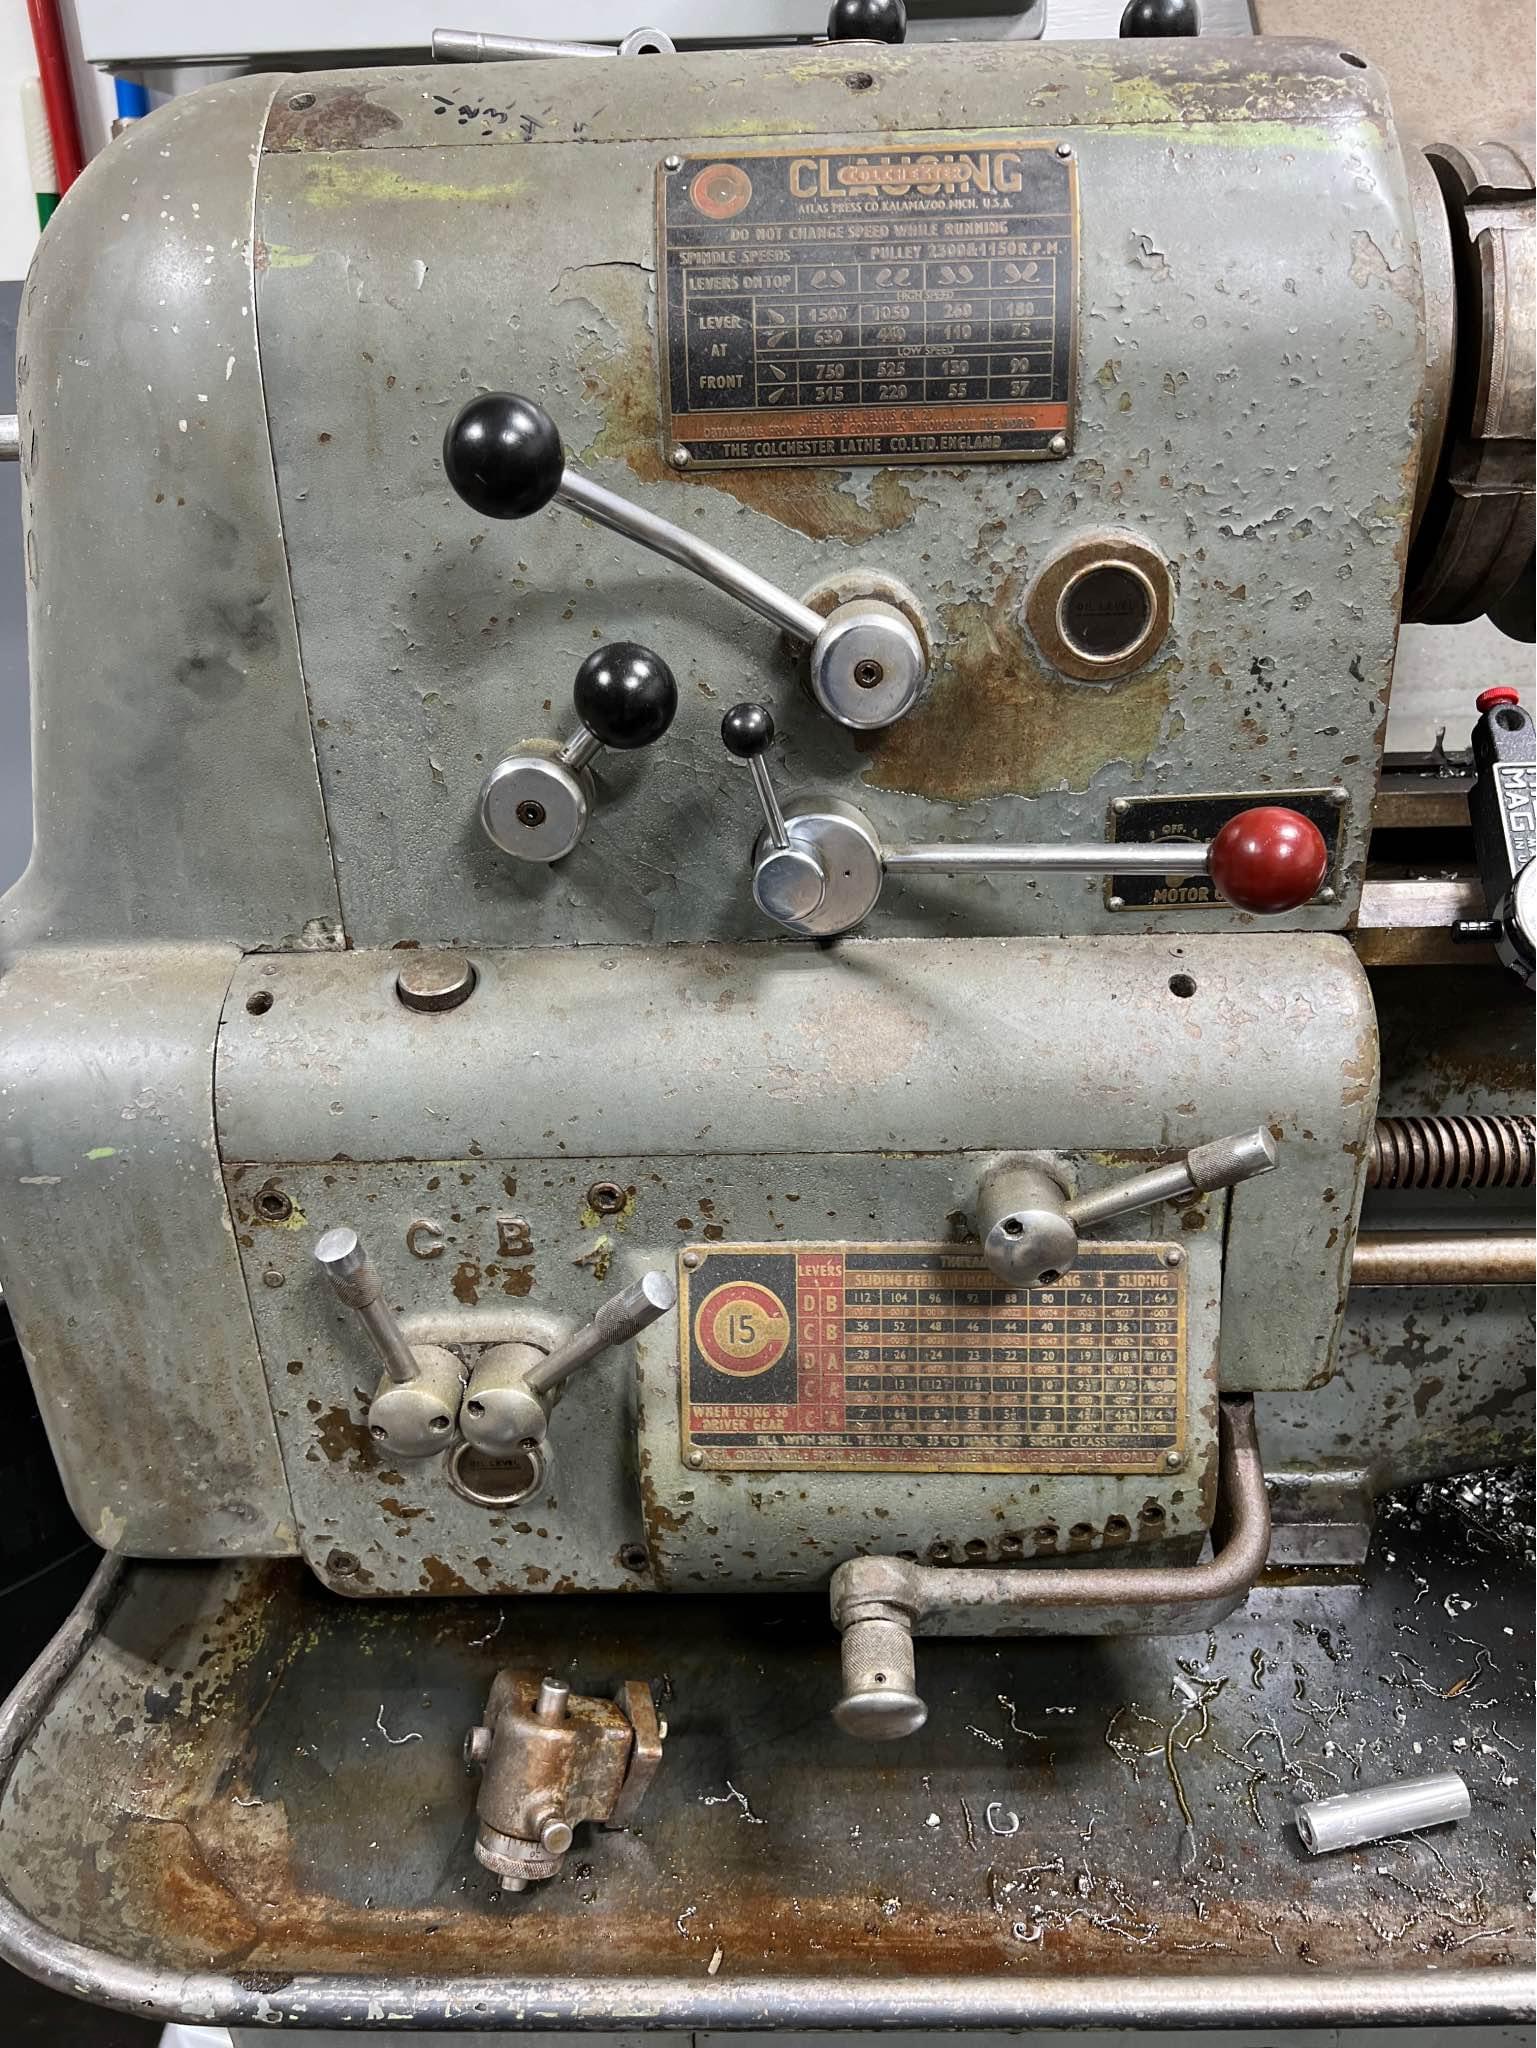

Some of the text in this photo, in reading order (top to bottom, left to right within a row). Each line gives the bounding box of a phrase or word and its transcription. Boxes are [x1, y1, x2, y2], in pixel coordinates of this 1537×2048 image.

[800, 203, 828, 214] ATLAS
[832, 202, 864, 213] PRESS
[730, 221, 1008, 241] DO NOT CHANGE SPEED WHILE RUNNING
[680, 248, 791, 265] SPINDLE SPEEDS
[871, 246, 922, 260] PULLEY
[690, 275, 792, 291] LEVERS ON TOP
[809, 307, 848, 324] 1500
[873, 304, 910, 321] 1050
[700, 316, 742, 330] LEVER
[1012, 323, 1031, 339] 75
[711, 344, 727, 357] AT
[898, 346, 955, 357] LOW SPEED
[816, 364, 845, 380] 750
[877, 361, 906, 377] 525
[1010, 357, 1030, 373] 90
[700, 375, 744, 390] FRONT
[816, 381, 1031, 402] 315 220 55 37
[723, 443, 748, 457] THE
[754, 440, 836, 456] COLCHESTER
[840, 438, 881, 454] LATHE
[1153, 887, 1209, 903] MOTOR
[406, 1219, 446, 1260] C
[496, 1216, 534, 1257] B
[799, 1264, 842, 1277] LEVERS
[856, 1275, 906, 1287] SLIDING
[1118, 1274, 1169, 1287] SLIDING
[803, 1294, 838, 1312] D B
[854, 1292, 871, 1304] 112
[891, 1292, 907, 1304] 104
[928, 1292, 941, 1304] 96
[1041, 1293, 1054, 1304] 80
[1080, 1293, 1092, 1304] 76
[1117, 1293, 1130, 1304] 72
[1154, 1293, 1167, 1304] 64
[729, 1314, 756, 1345] 15
[803, 1323, 815, 1341] C
[826, 1324, 838, 1341] B
[857, 1321, 1167, 1333] 56 52 48 46 44 40 38 36 32
[803, 1353, 839, 1370] D A
[857, 1350, 1167, 1361] 28 26 24 23 22 20 19 18 16
[894, 1379, 905, 1390] 13
[932, 1379, 942, 1390] 12
[1006, 1379, 1015, 1390] 11
[1042, 1381, 1053, 1391] 10
[1119, 1380, 1126, 1391] 9
[692, 1406, 730, 1419] WHEN
[734, 1406, 770, 1419] USING
[702, 1419, 785, 1432] DRIVER GEAR
[757, 1435, 780, 1445] FILL
[783, 1435, 816, 1445] WITH
[817, 1435, 853, 1446] SHELL
[857, 1436, 898, 1446] TELLUS
[902, 1435, 922, 1446] OIL
[942, 1436, 960, 1446] TO
[1029, 1436, 1066, 1447] SIGHT
[1070, 1437, 1108, 1447] GLASS
